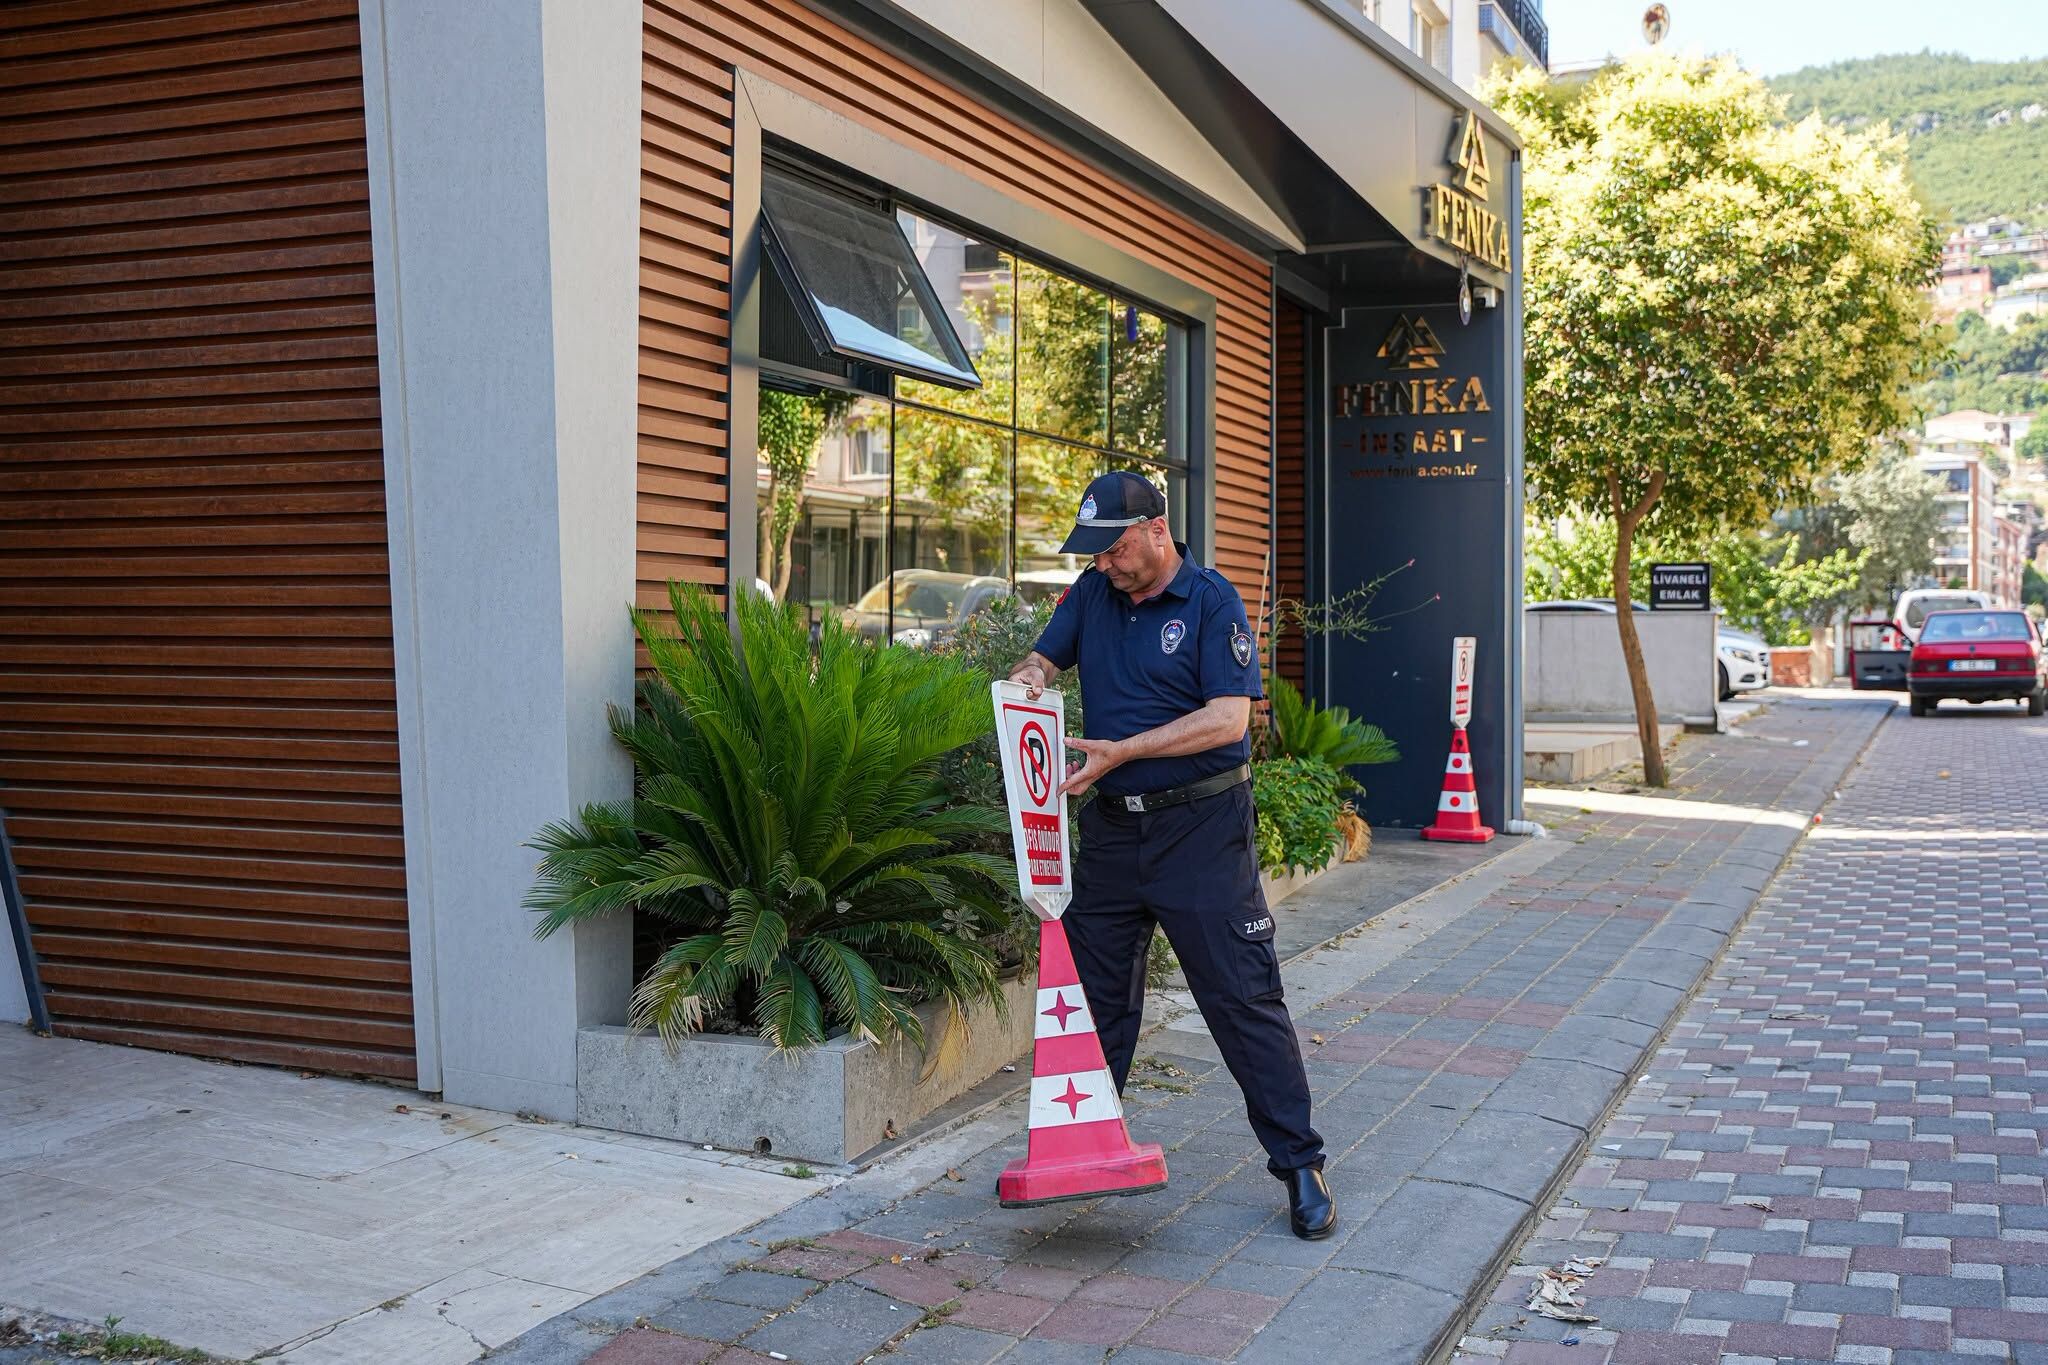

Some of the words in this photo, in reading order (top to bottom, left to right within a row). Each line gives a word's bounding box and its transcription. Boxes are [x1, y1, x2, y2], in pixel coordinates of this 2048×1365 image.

[1435, 182, 1512, 274] FENKA
[1336, 376, 1491, 418] FENKA
[1653, 572, 1707, 585] LİVANELİ
[1660, 590, 1700, 600] EMLAK
